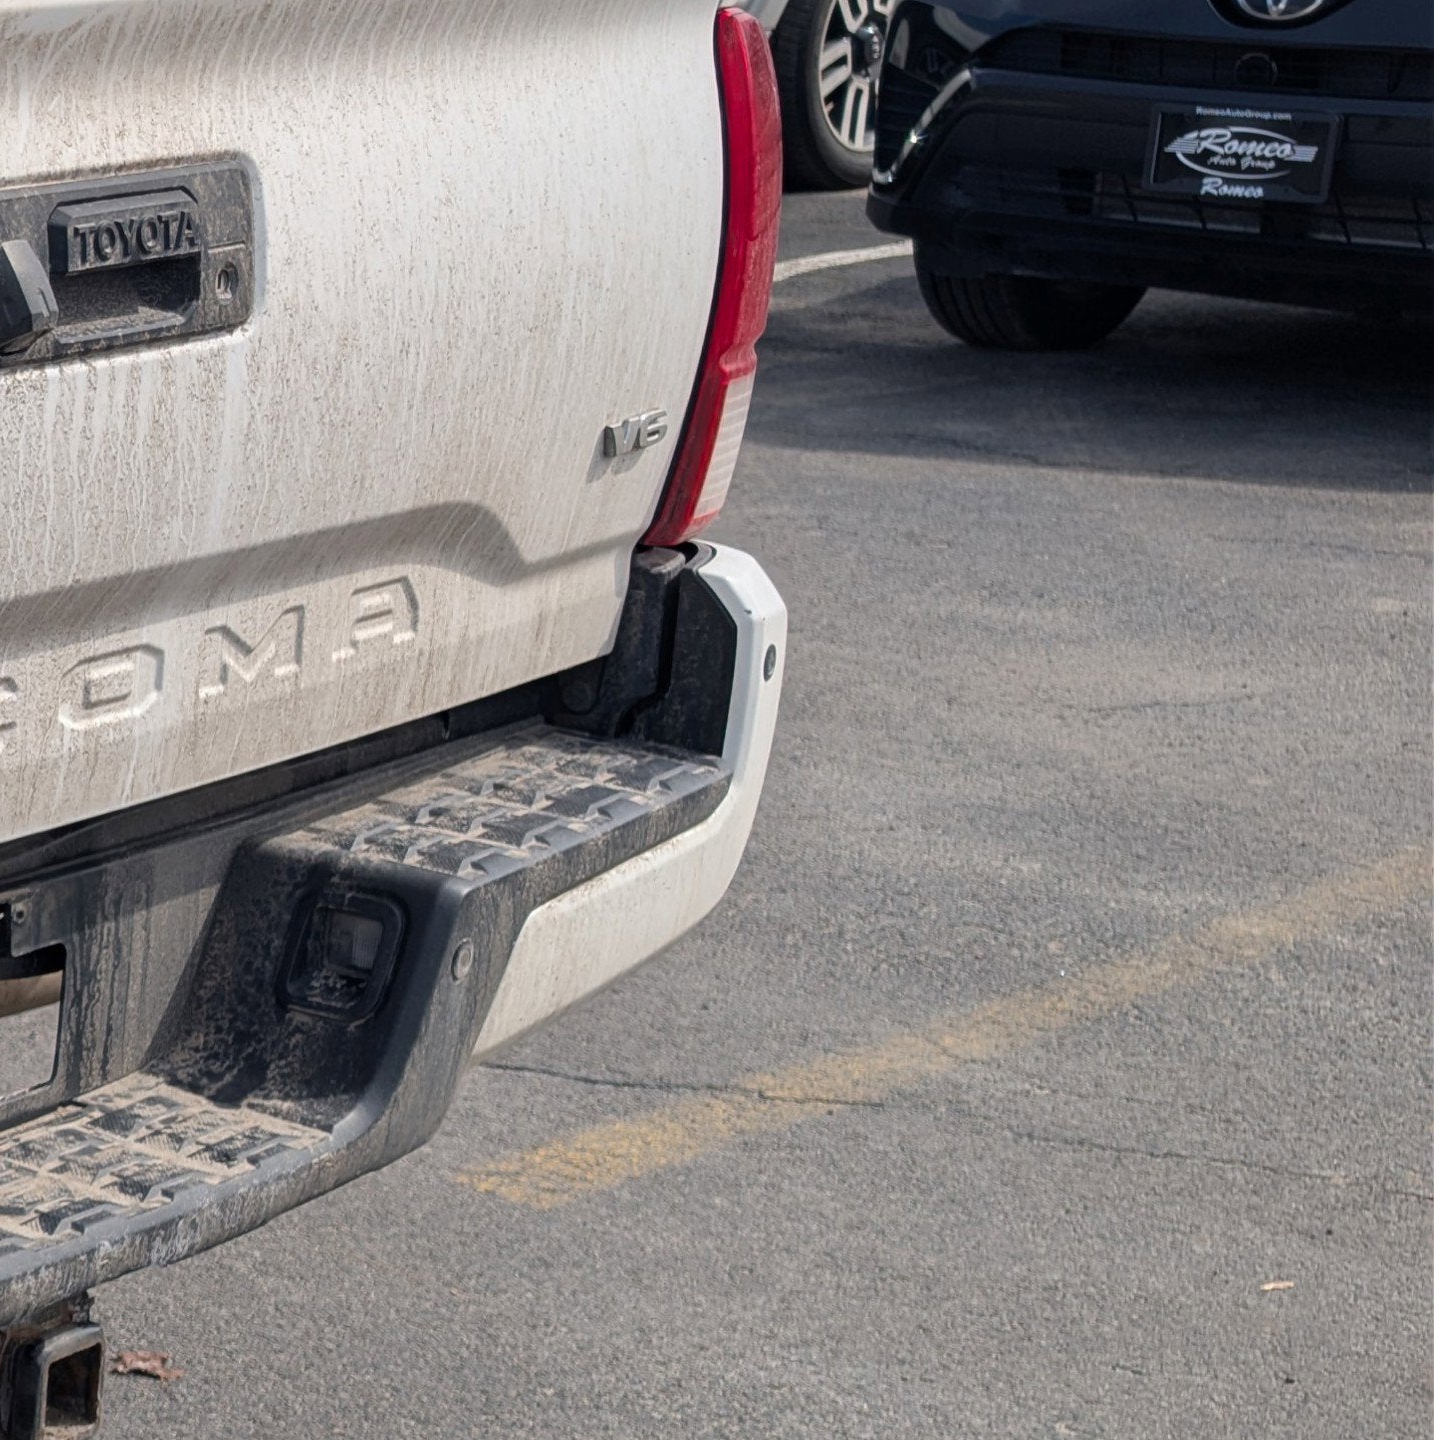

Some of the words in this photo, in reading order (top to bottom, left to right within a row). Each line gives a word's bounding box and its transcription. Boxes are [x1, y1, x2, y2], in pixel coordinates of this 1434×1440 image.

[1197, 127, 1295, 159] Romeo
[1200, 176, 1264, 199] Romeo
[73, 211, 200, 265] TOYOTA
[602, 408, 668, 458] V6
